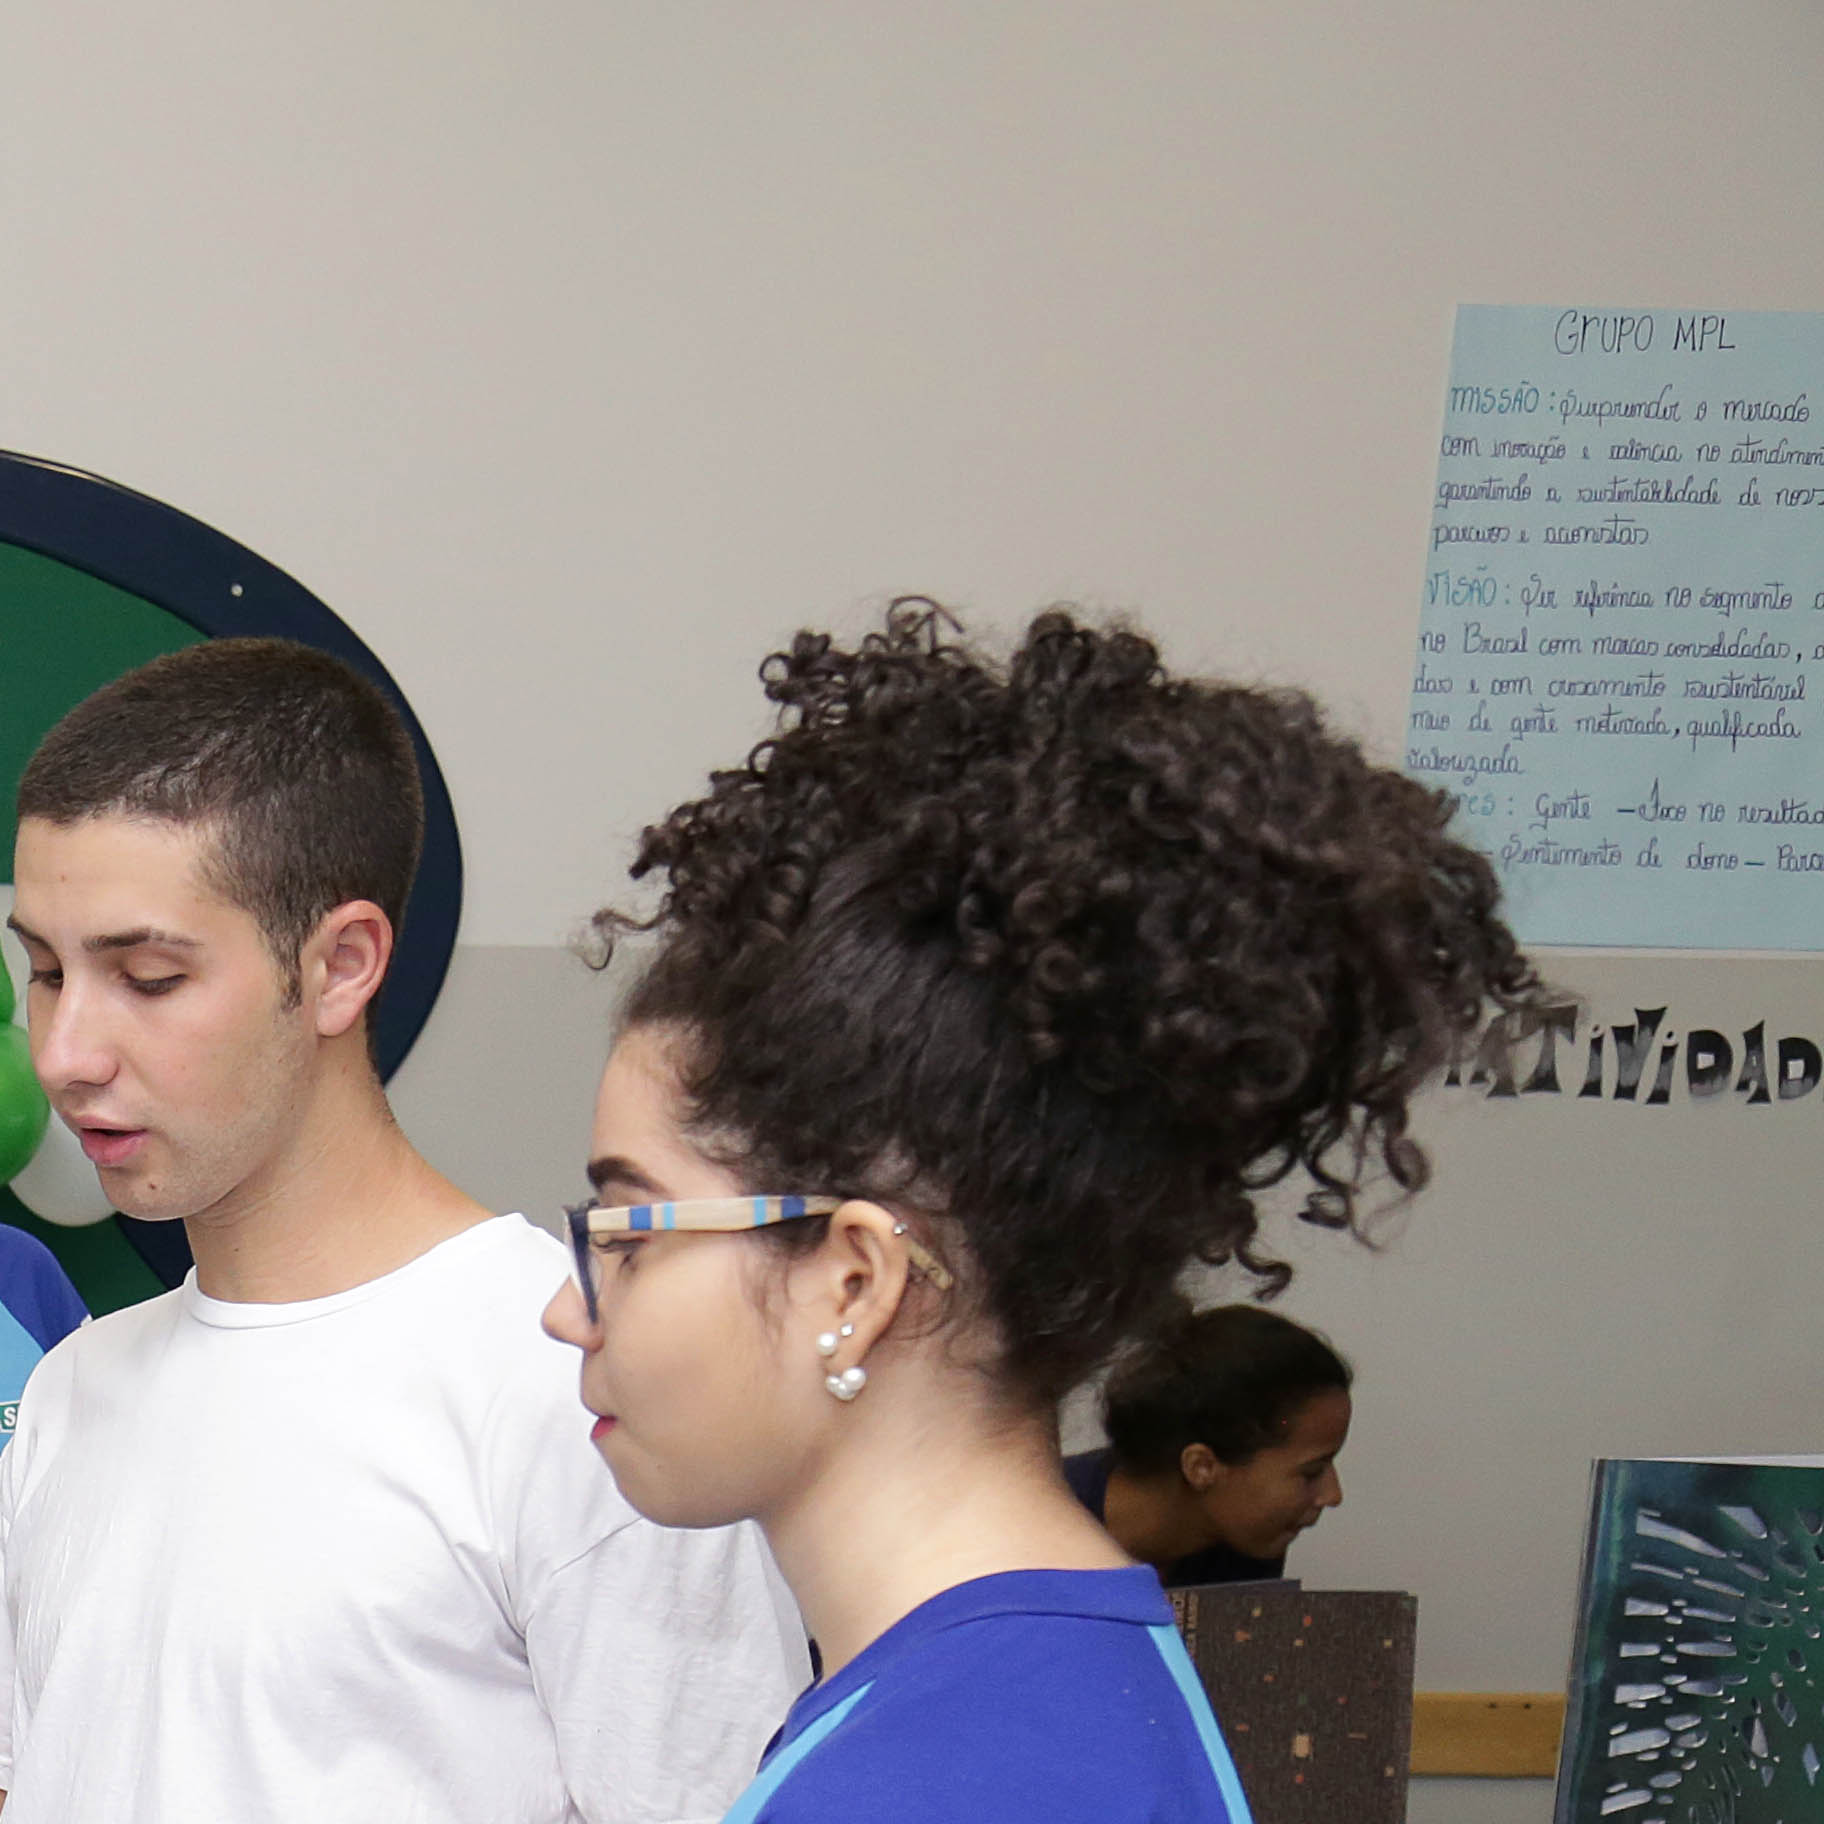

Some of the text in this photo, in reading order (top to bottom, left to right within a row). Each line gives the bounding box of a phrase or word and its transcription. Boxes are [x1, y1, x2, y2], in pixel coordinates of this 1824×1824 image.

[1673, 314, 1736, 353] MPL
[1723, 393, 1810, 422] mercado
[1441, 435, 1481, 457] com
[1697, 443, 1721, 462] no
[1737, 476, 1762, 506] de
[1665, 586, 1692, 608] no
[1420, 631, 1446, 654] no
[1463, 621, 1529, 655] Brasil
[1538, 636, 1583, 656] com
[1468, 699, 1493, 733] de
[1686, 706, 1803, 753] qualificada
[1529, 788, 1592, 831] Gente
[1697, 801, 1726, 824] no
[1636, 836, 1664, 870] de
[1685, 841, 1739, 872] dono
